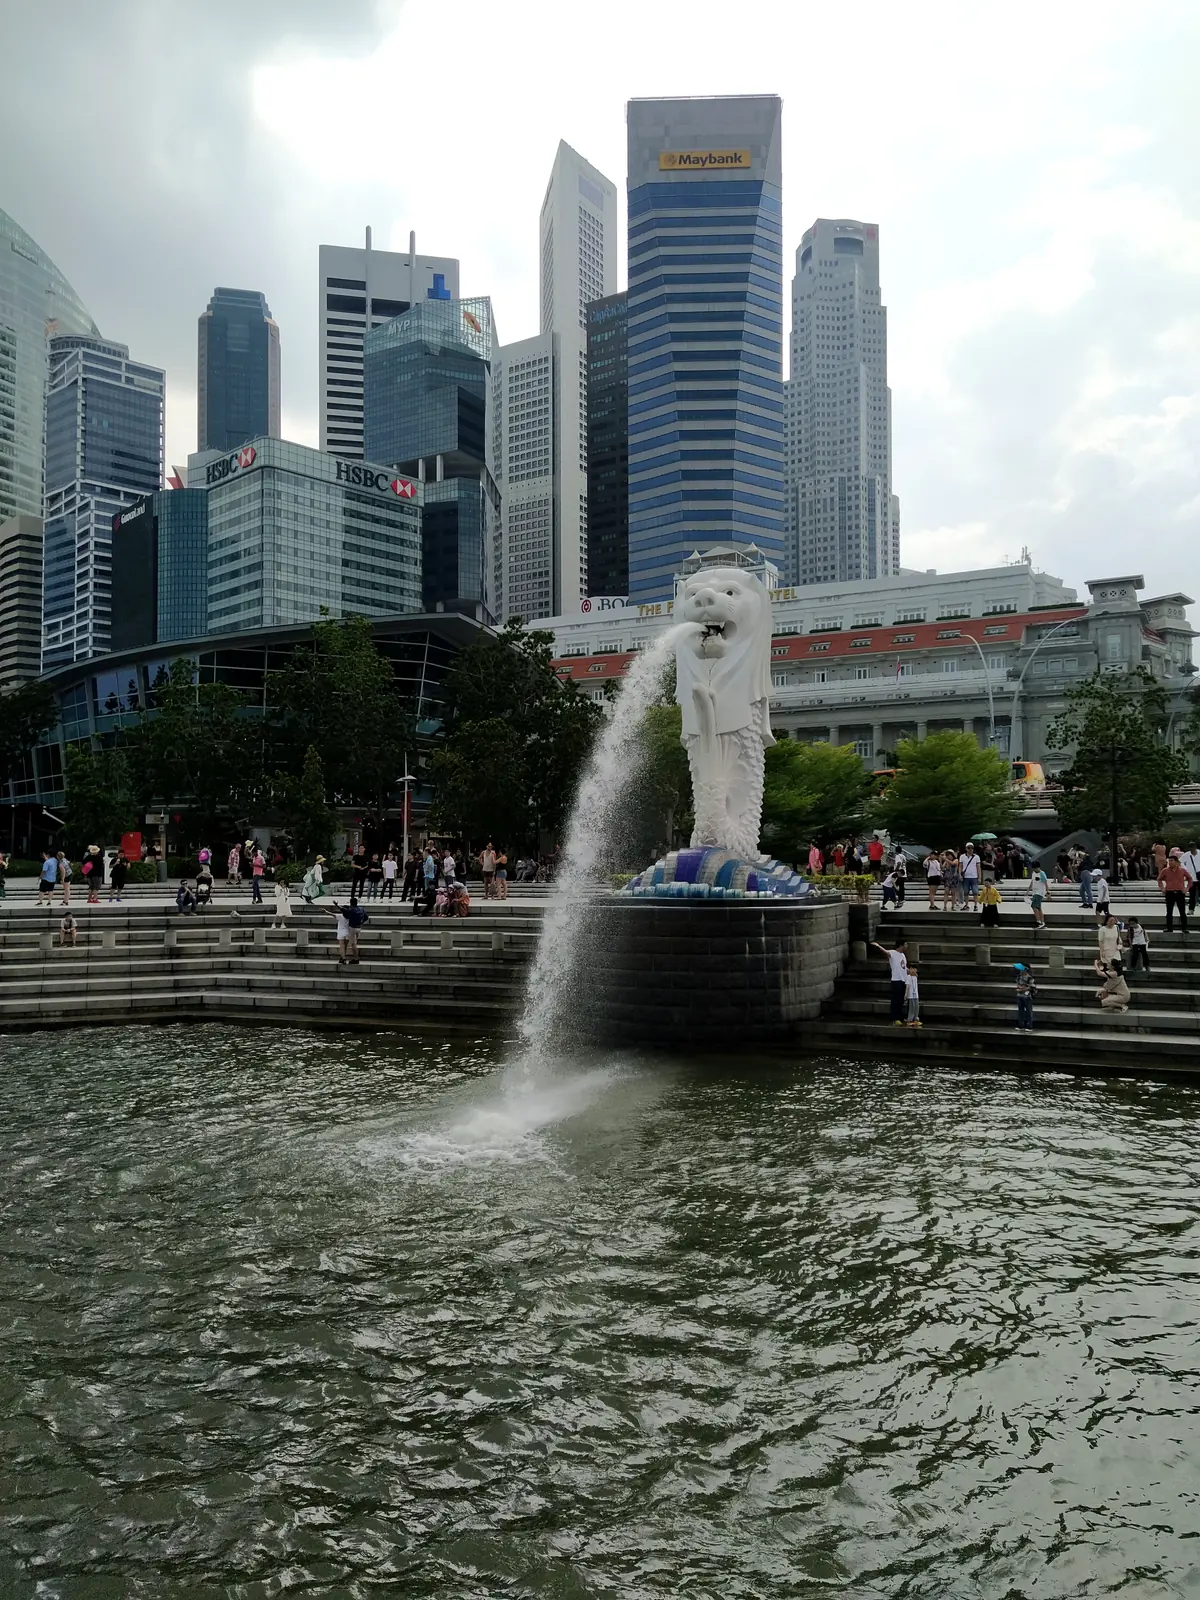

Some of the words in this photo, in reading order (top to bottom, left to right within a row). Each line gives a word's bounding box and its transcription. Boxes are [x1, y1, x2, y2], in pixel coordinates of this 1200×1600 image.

[678, 153, 743, 166] Maybank
[388, 320, 411, 336] MYP
[206, 453, 238, 485] HSBC
[336, 461, 389, 492] HSBC
[637, 604, 662, 617] THE
